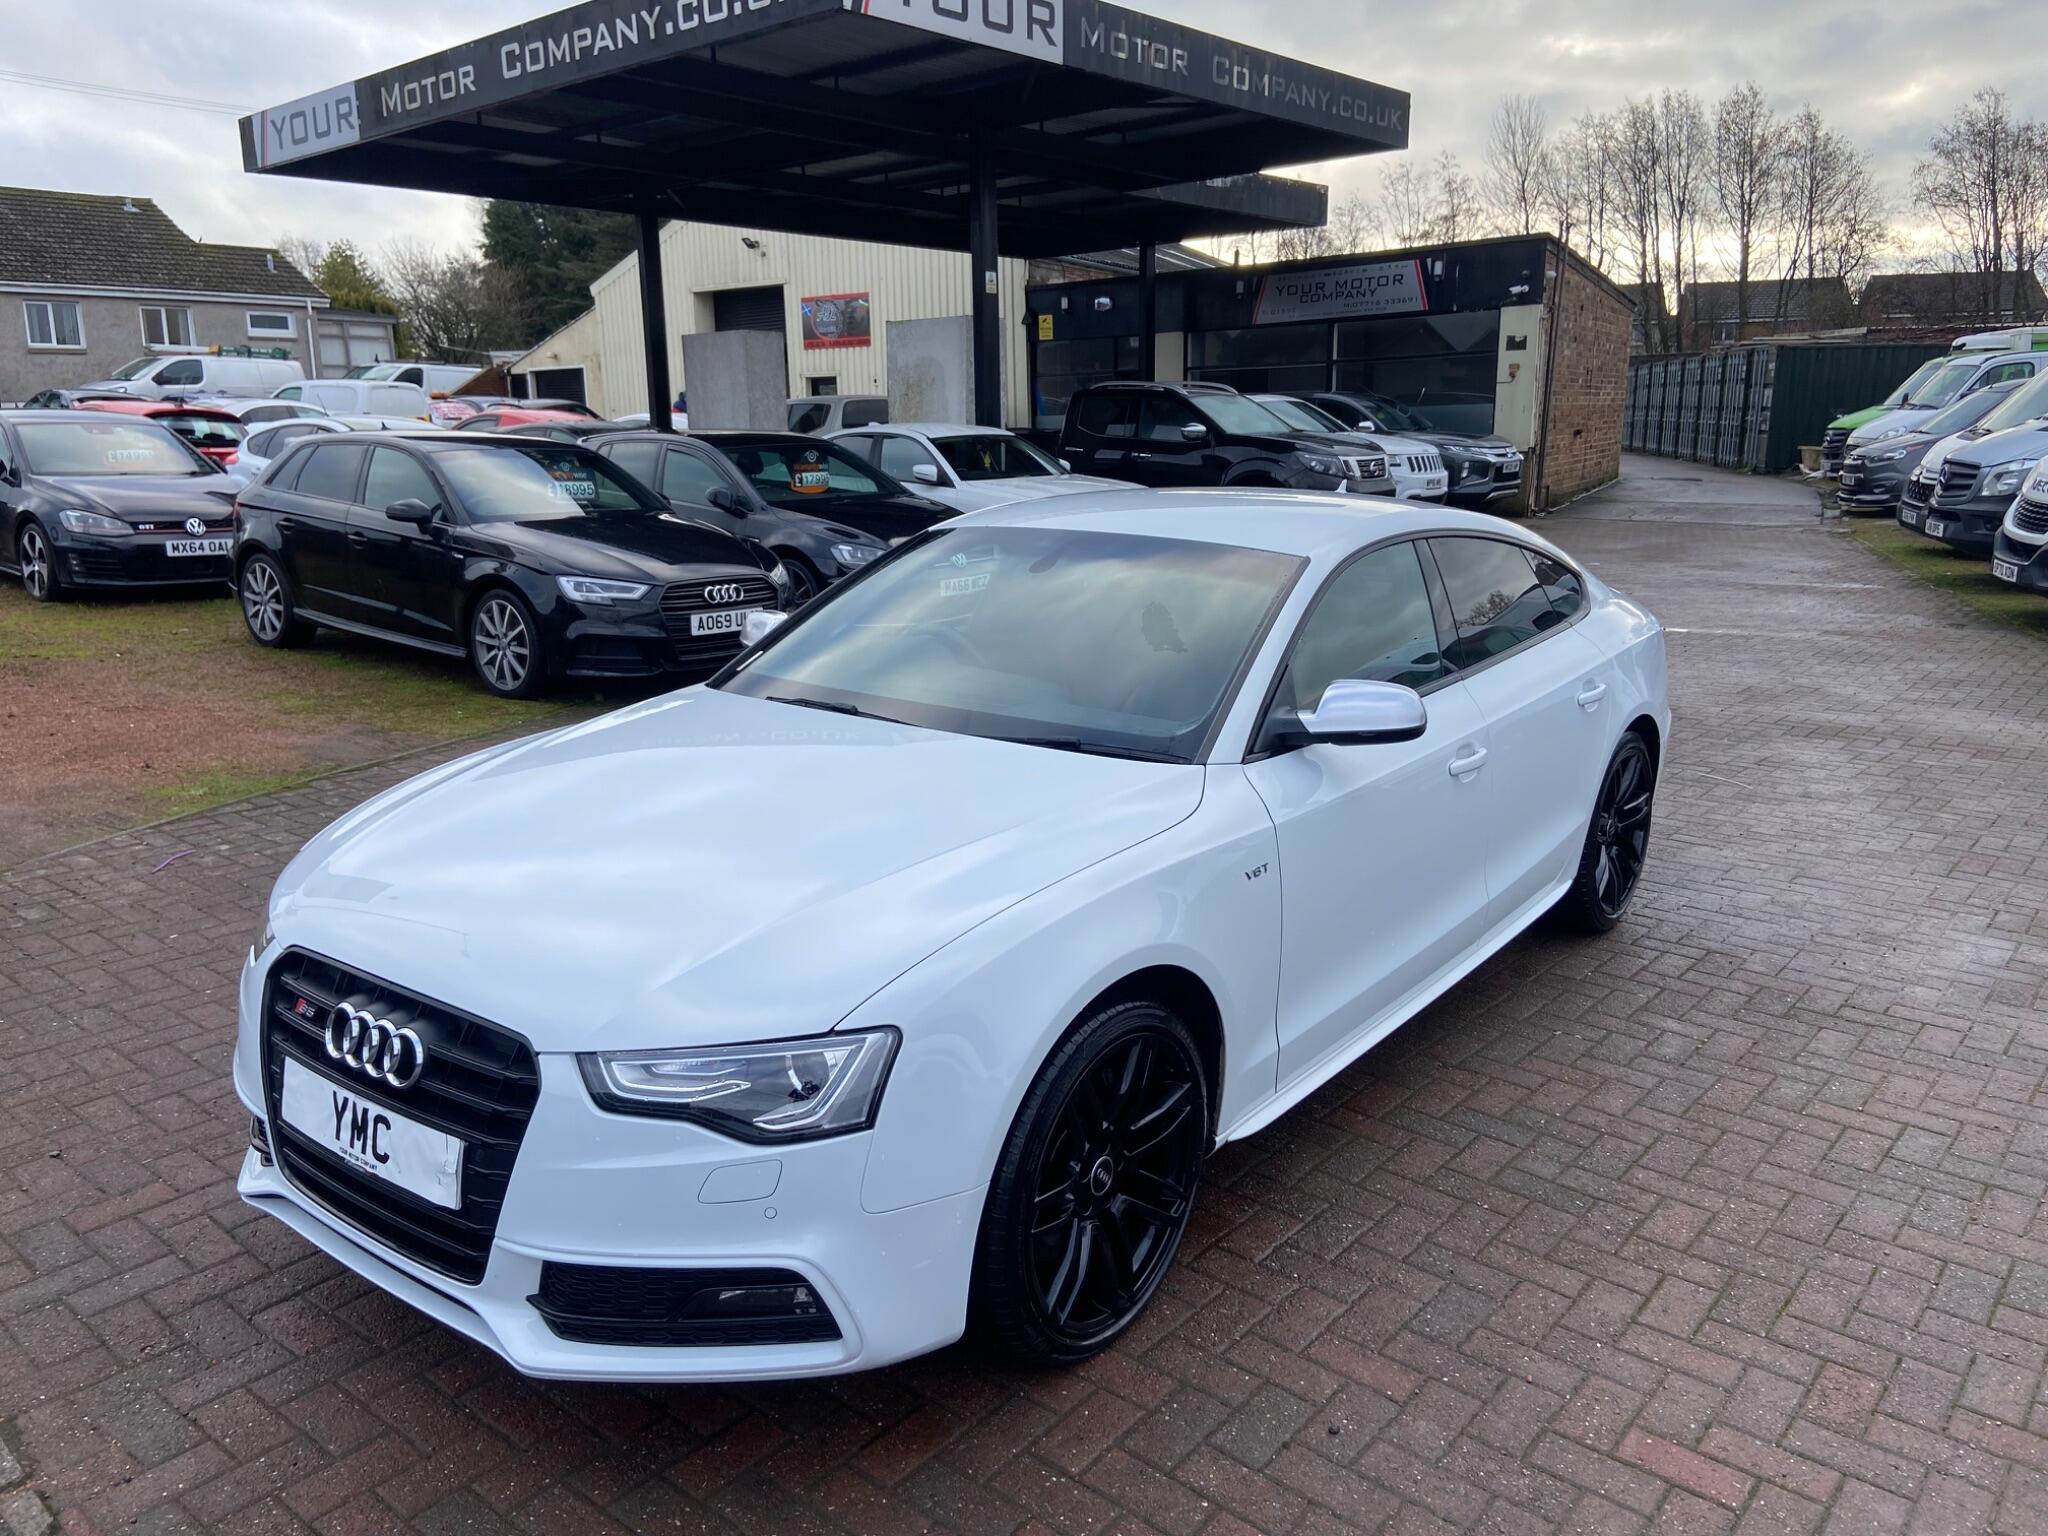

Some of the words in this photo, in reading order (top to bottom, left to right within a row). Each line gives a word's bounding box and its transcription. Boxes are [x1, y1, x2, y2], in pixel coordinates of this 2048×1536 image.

[270, 96, 355, 149] YOUR
[381, 65, 476, 117] MOTOR
[501, 0, 788, 79] COMPANY.CO.
[1081, 16, 1188, 76] MOTOR
[1213, 56, 1401, 130] COMPANY.CO.UK
[1275, 281, 1326, 297] YOUR
[1335, 274, 1404, 290] MOTOR
[1300, 288, 1378, 304] COMPANY
[171, 541, 205, 554] MX64
[333, 1090, 391, 1165] YMC
